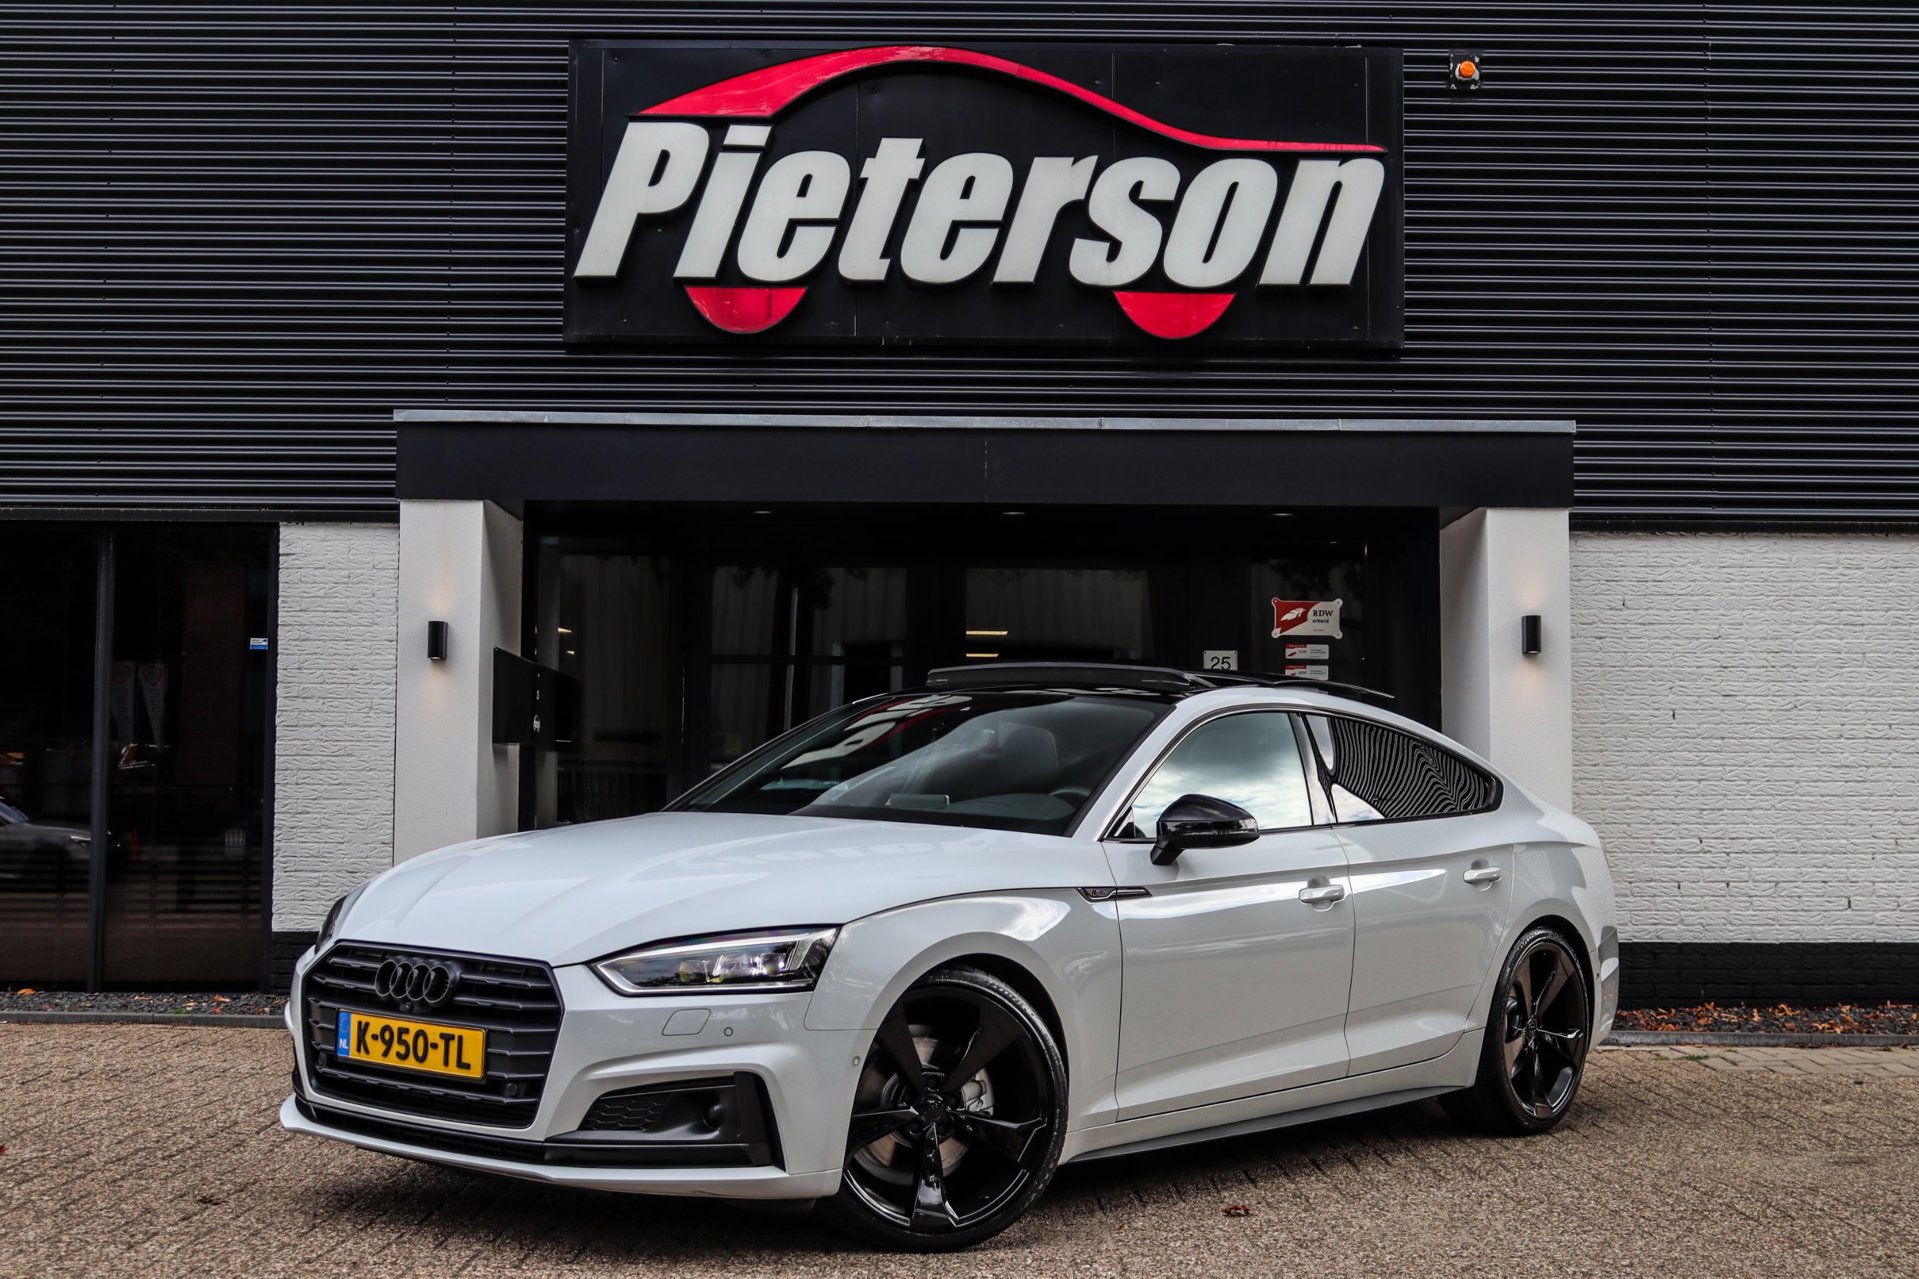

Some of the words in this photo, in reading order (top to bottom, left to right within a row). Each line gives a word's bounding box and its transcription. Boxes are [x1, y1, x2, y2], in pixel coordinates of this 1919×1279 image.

[573, 120, 1386, 289] Pieterson
[1312, 609, 1334, 617] RDW
[1210, 656, 1231, 670] 25
[339, 1038, 349, 1049] NL
[356, 1020, 472, 1070] K-950-TL
